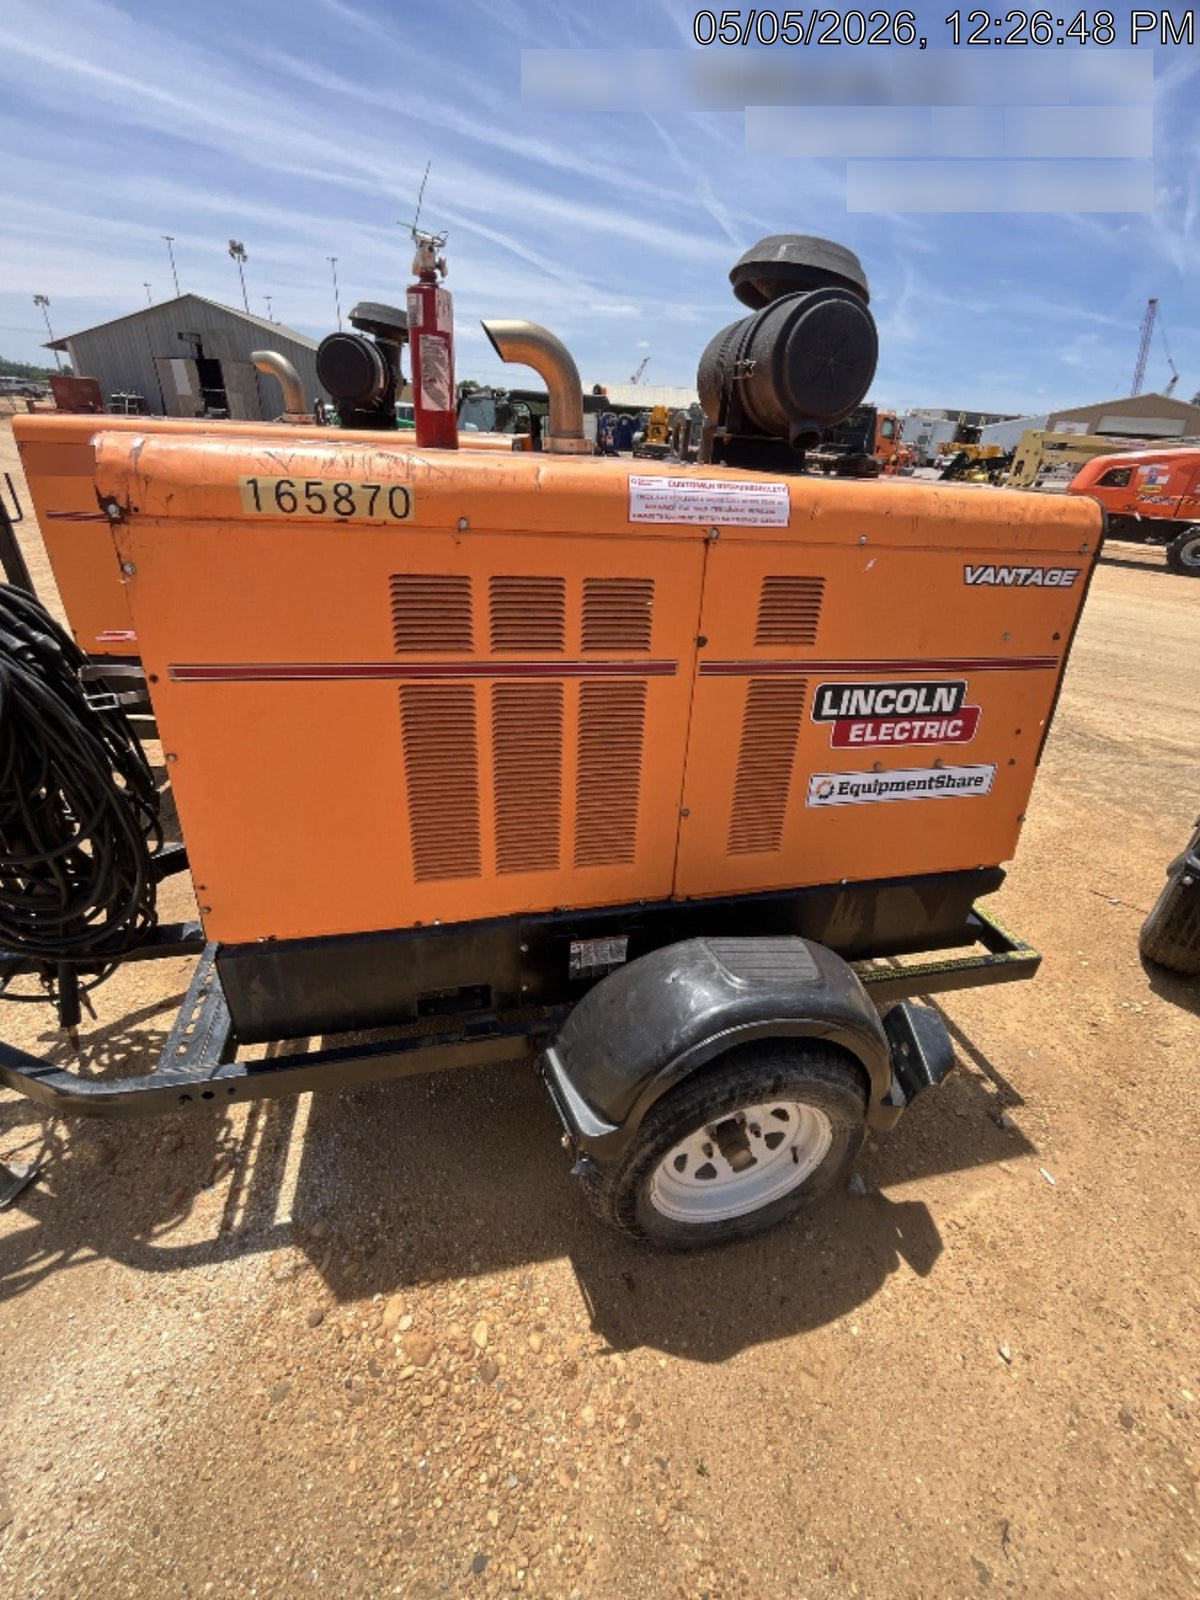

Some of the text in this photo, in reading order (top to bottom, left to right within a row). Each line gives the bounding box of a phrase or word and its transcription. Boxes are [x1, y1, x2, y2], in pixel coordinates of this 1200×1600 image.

[246, 477, 411, 520] 165870
[963, 566, 1079, 587] VANTAGE
[820, 686, 958, 717] LINCOLN
[848, 719, 965, 743] ELECTRIC
[836, 773, 985, 798] EquipmentShare
